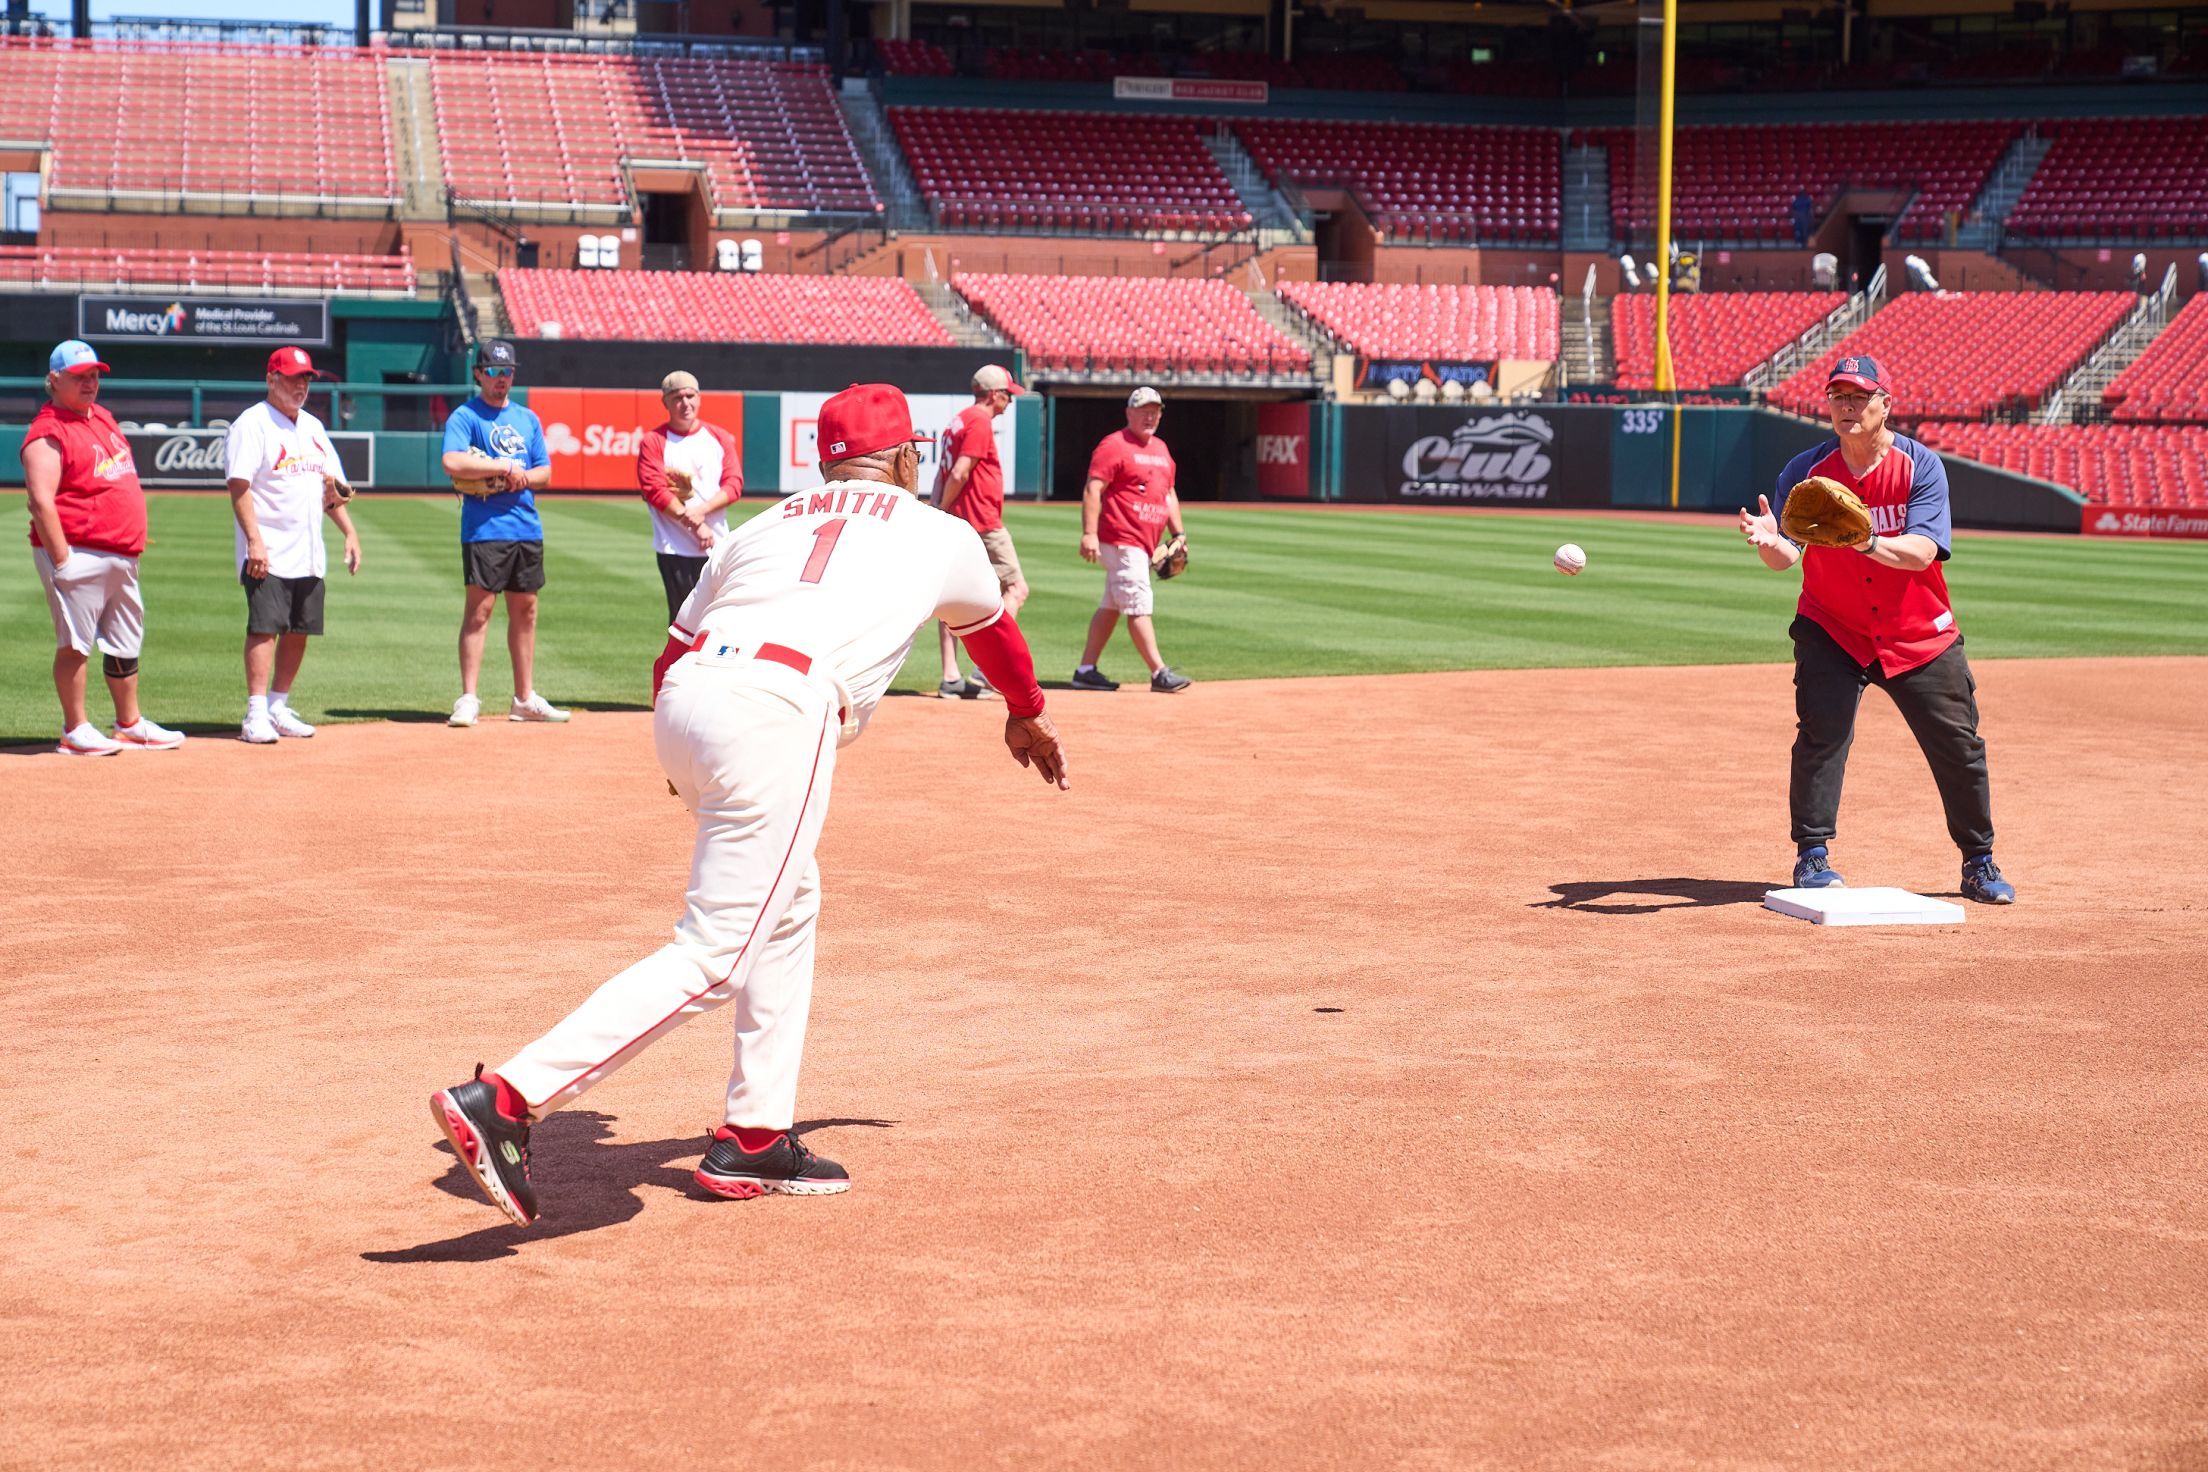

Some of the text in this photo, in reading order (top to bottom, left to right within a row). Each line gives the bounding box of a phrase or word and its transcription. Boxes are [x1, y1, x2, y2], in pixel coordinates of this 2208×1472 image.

[106, 308, 169, 335] Mercy
[195, 307, 274, 321] Medical Provider
[195, 321, 205, 333] of
[206, 321, 221, 333] the
[234, 322, 257, 334] Louis
[258, 322, 299, 335] Cardinals
[1439, 367, 1487, 381] PATIO
[1402, 436, 1552, 483] Club
[783, 491, 899, 522] SMITH
[799, 518, 848, 584] 1
